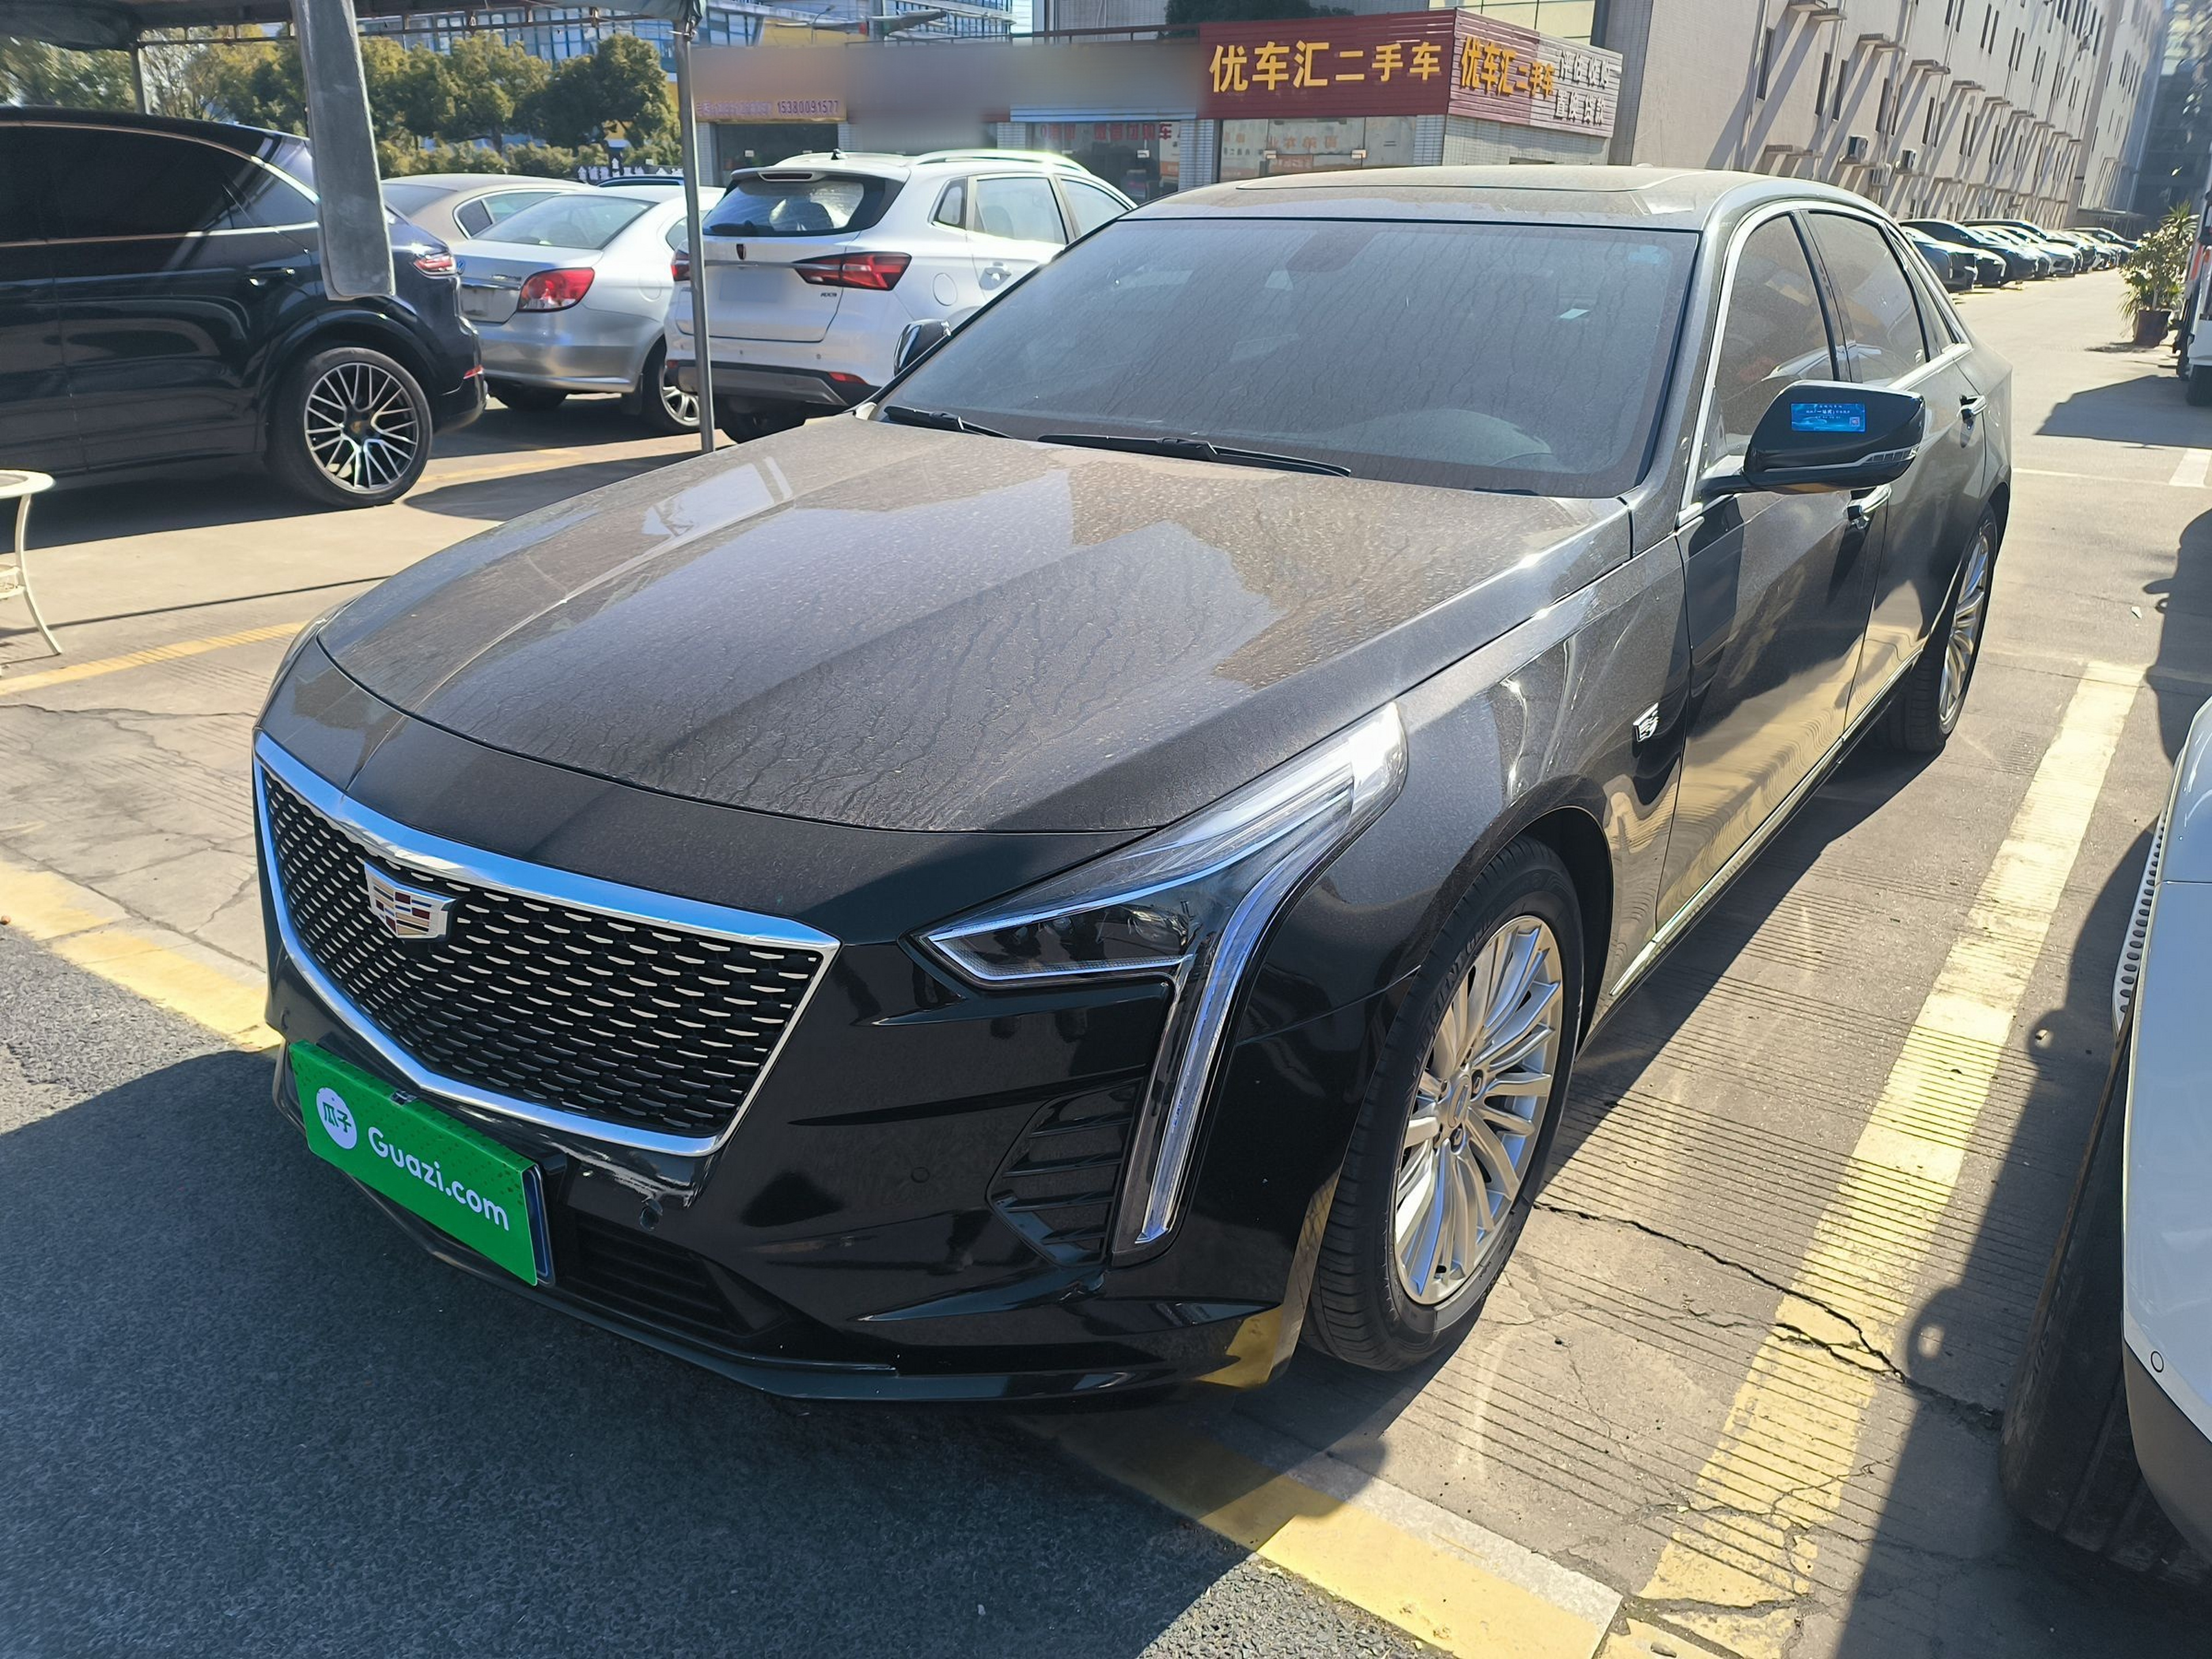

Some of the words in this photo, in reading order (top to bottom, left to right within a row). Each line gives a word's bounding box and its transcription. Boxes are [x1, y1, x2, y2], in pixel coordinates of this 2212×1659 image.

[1209, 40, 1442, 93] 优车汇二手车
[1460, 36, 1555, 97] 优车汇二手车
[777, 100, 839, 115] 15380091577
[322, 1102, 353, 1137] 瓜子
[368, 1126, 509, 1233] Guazi.com
